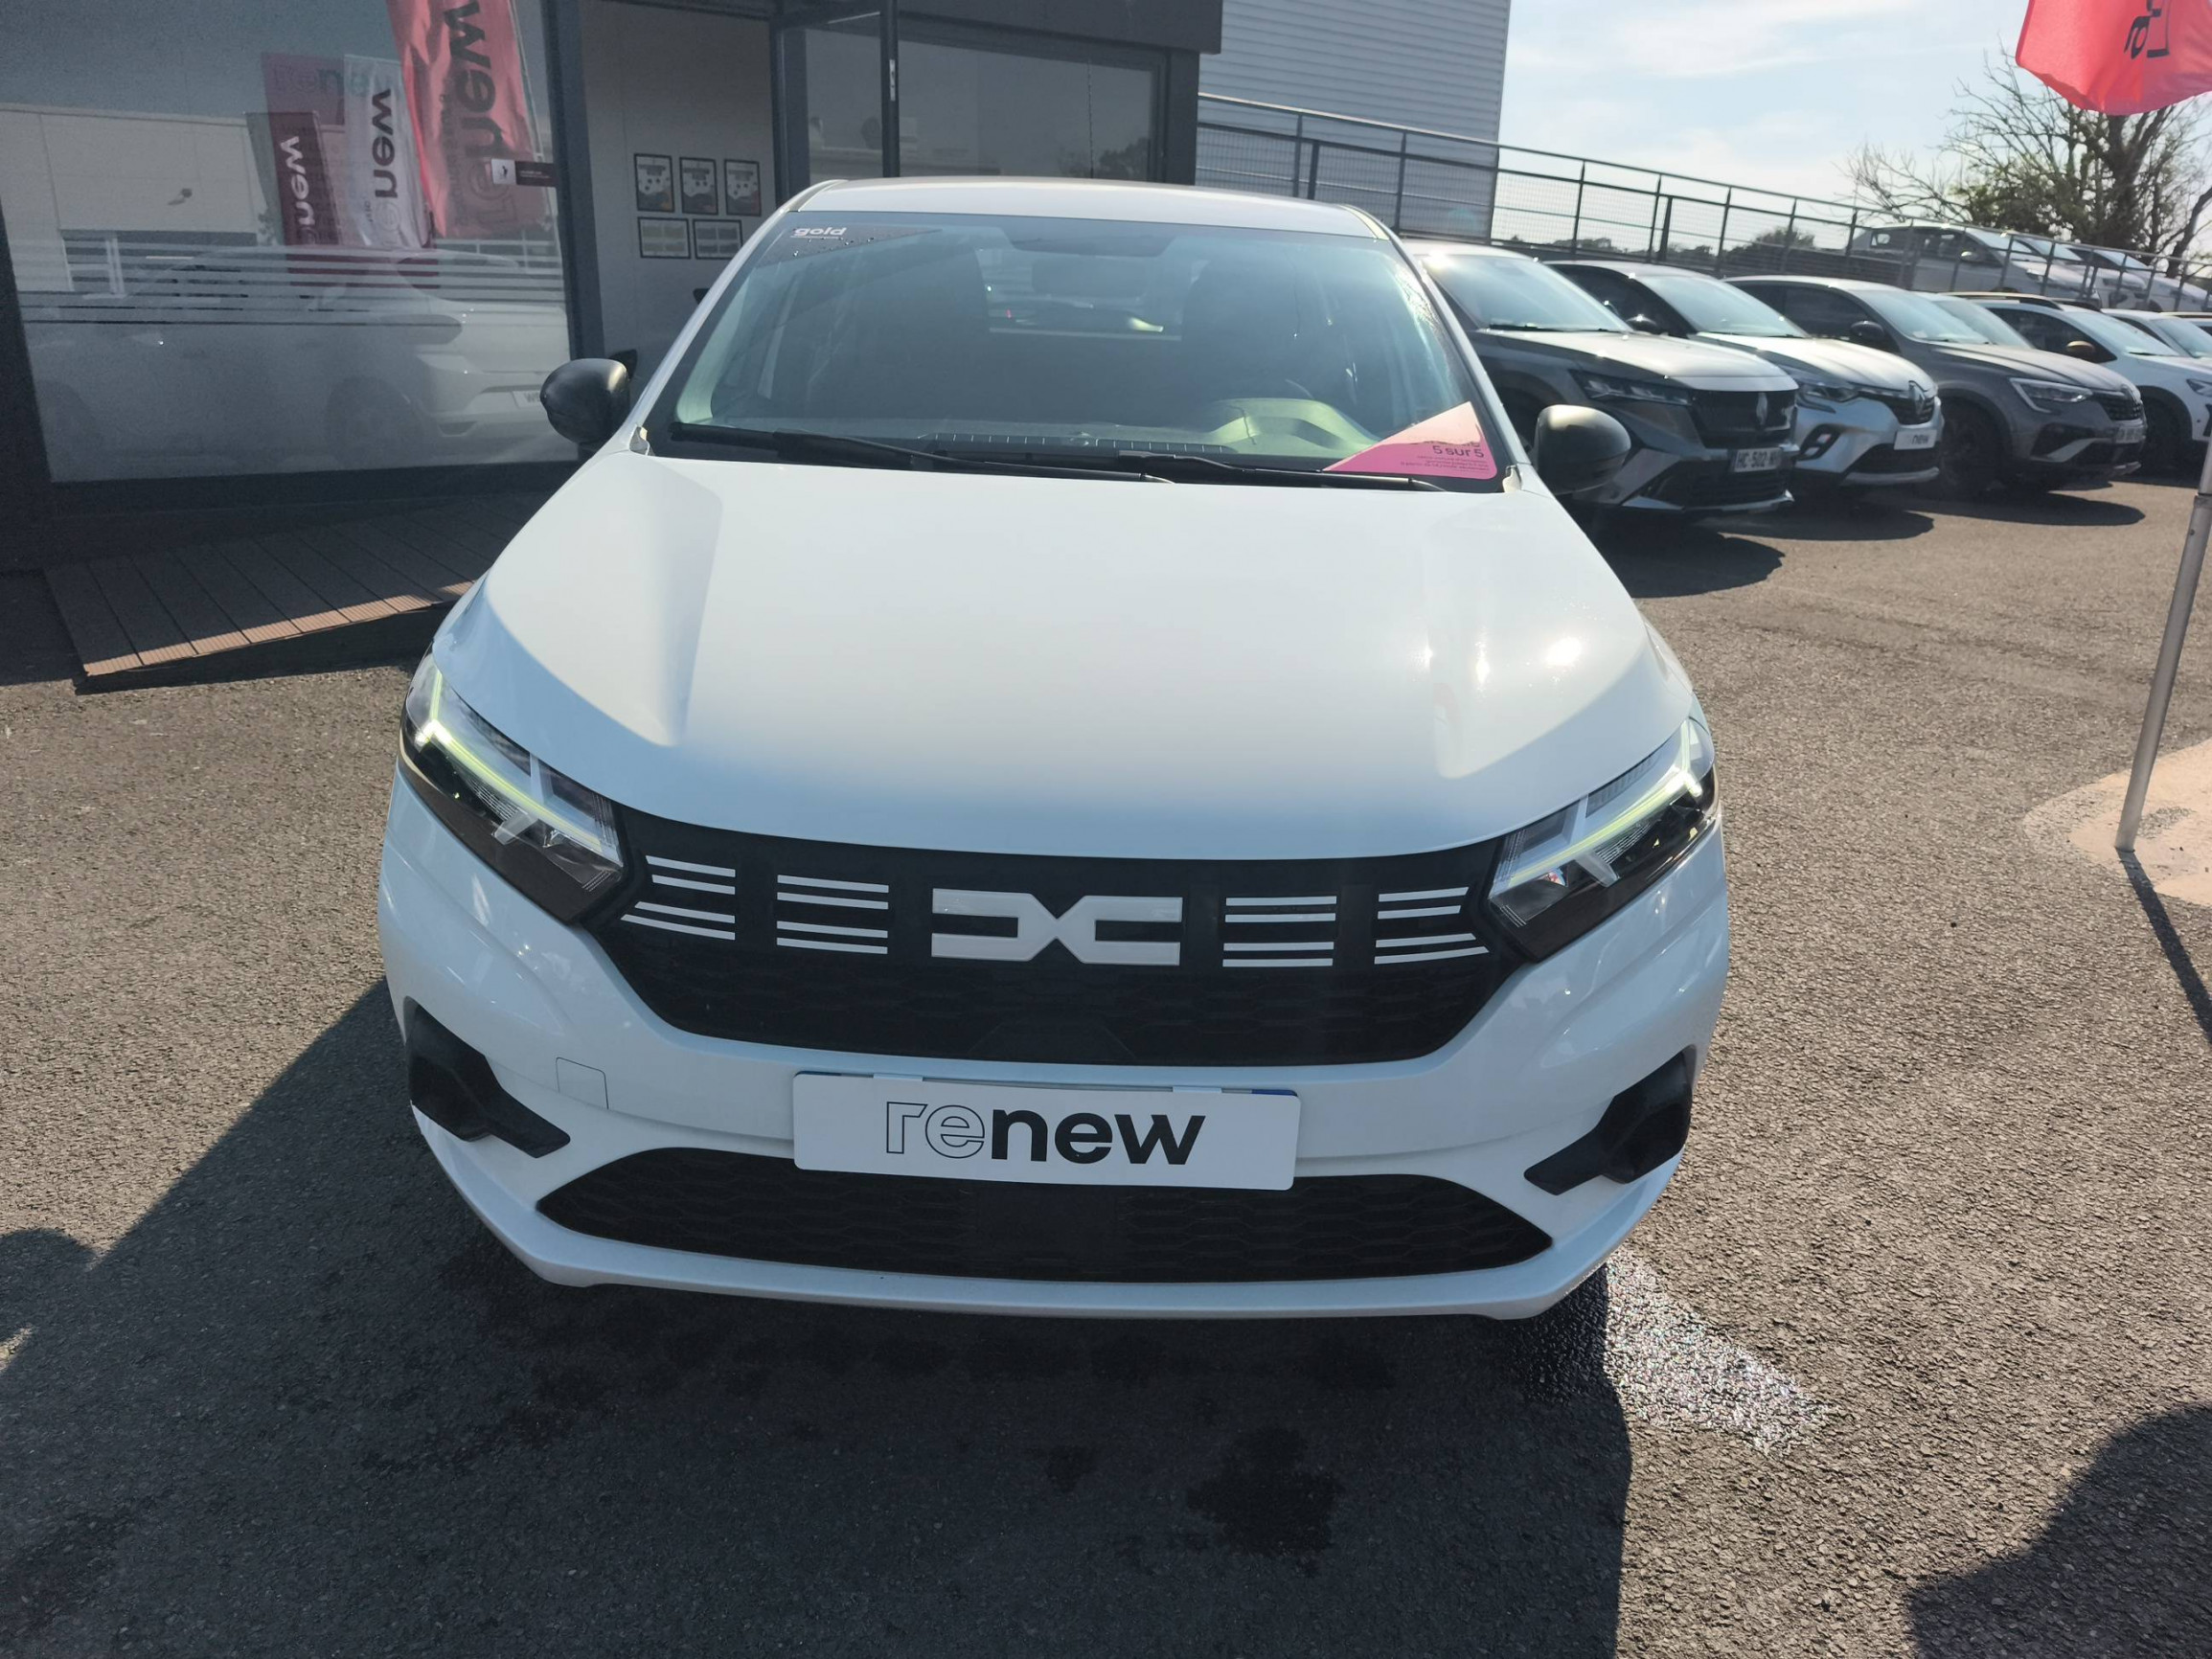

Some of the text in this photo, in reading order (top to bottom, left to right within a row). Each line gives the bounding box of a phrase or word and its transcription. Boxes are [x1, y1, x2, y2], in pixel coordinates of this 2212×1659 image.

[793, 226, 848, 237] gold
[1432, 444, 1444, 455] 5
[1445, 447, 1471, 457] sur
[1473, 447, 1485, 459] 5
[886, 1101, 1207, 1166] renew
